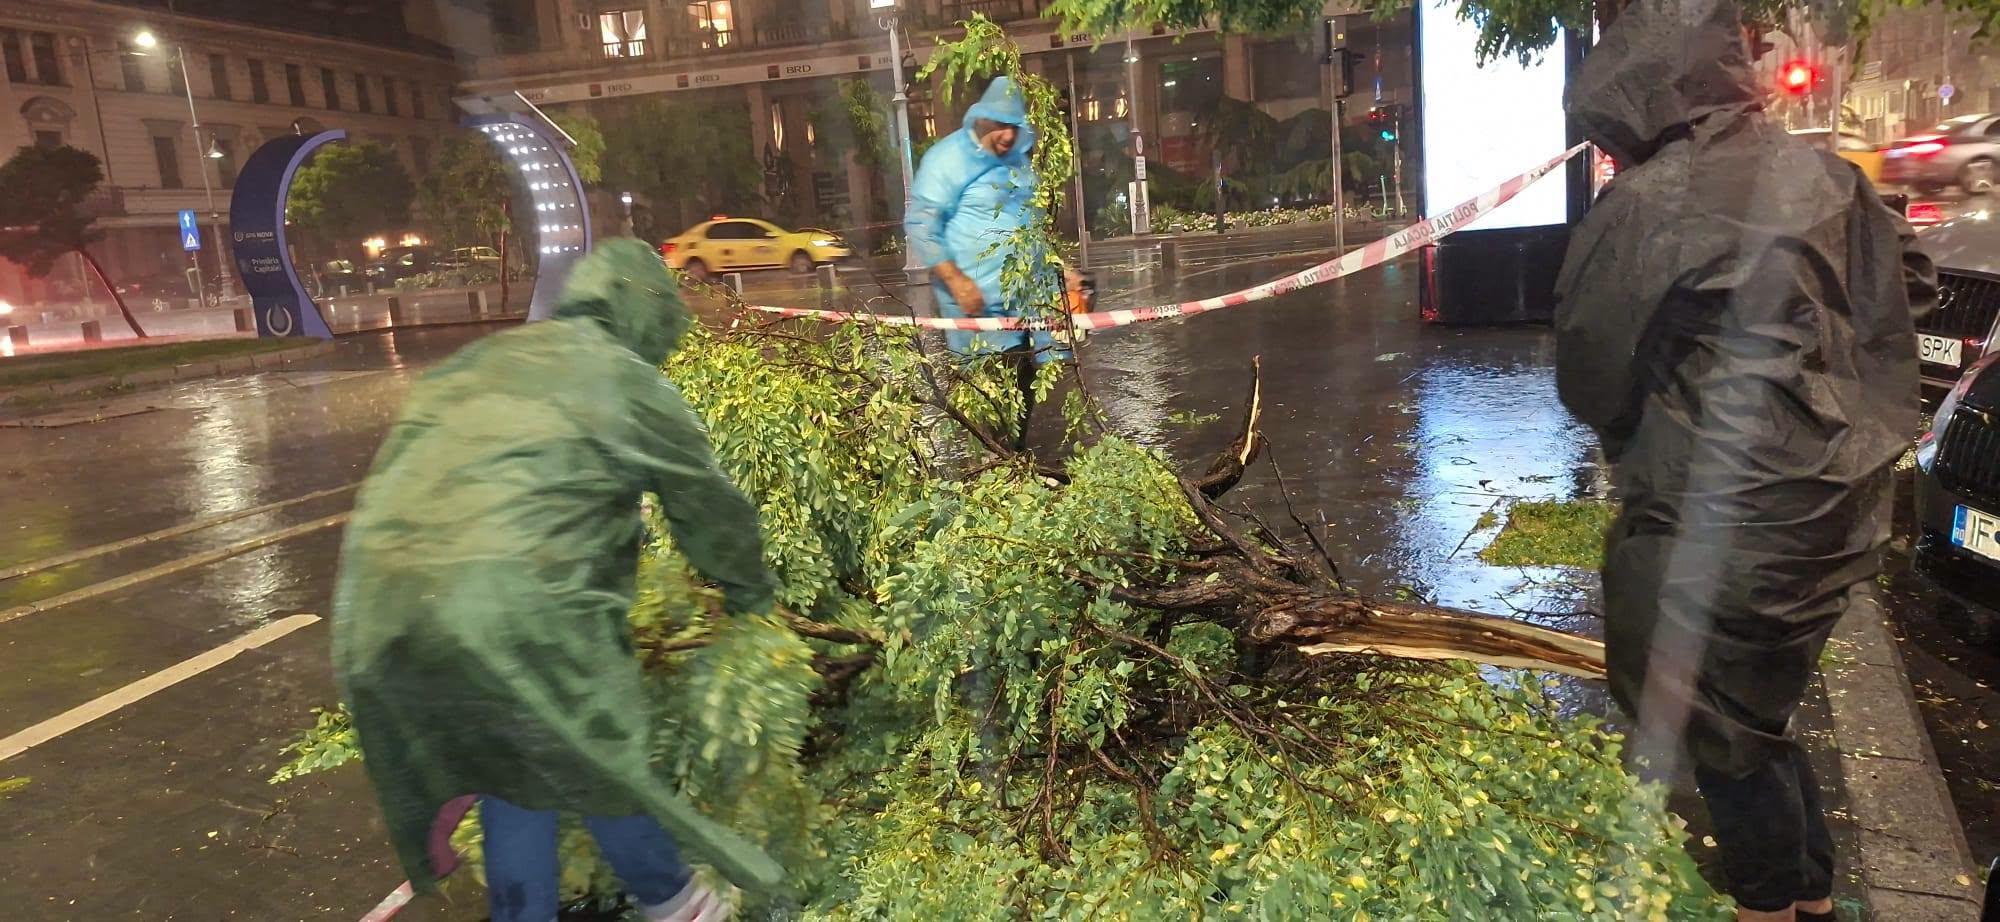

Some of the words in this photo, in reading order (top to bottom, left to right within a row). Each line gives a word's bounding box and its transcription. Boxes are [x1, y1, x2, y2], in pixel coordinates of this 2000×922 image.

[786, 64, 812, 74] BRD
[695, 73, 720, 83] BRD
[607, 83, 633, 93] BRD
[1922, 338, 1955, 361] SPK
[1971, 514, 1994, 548] IF
